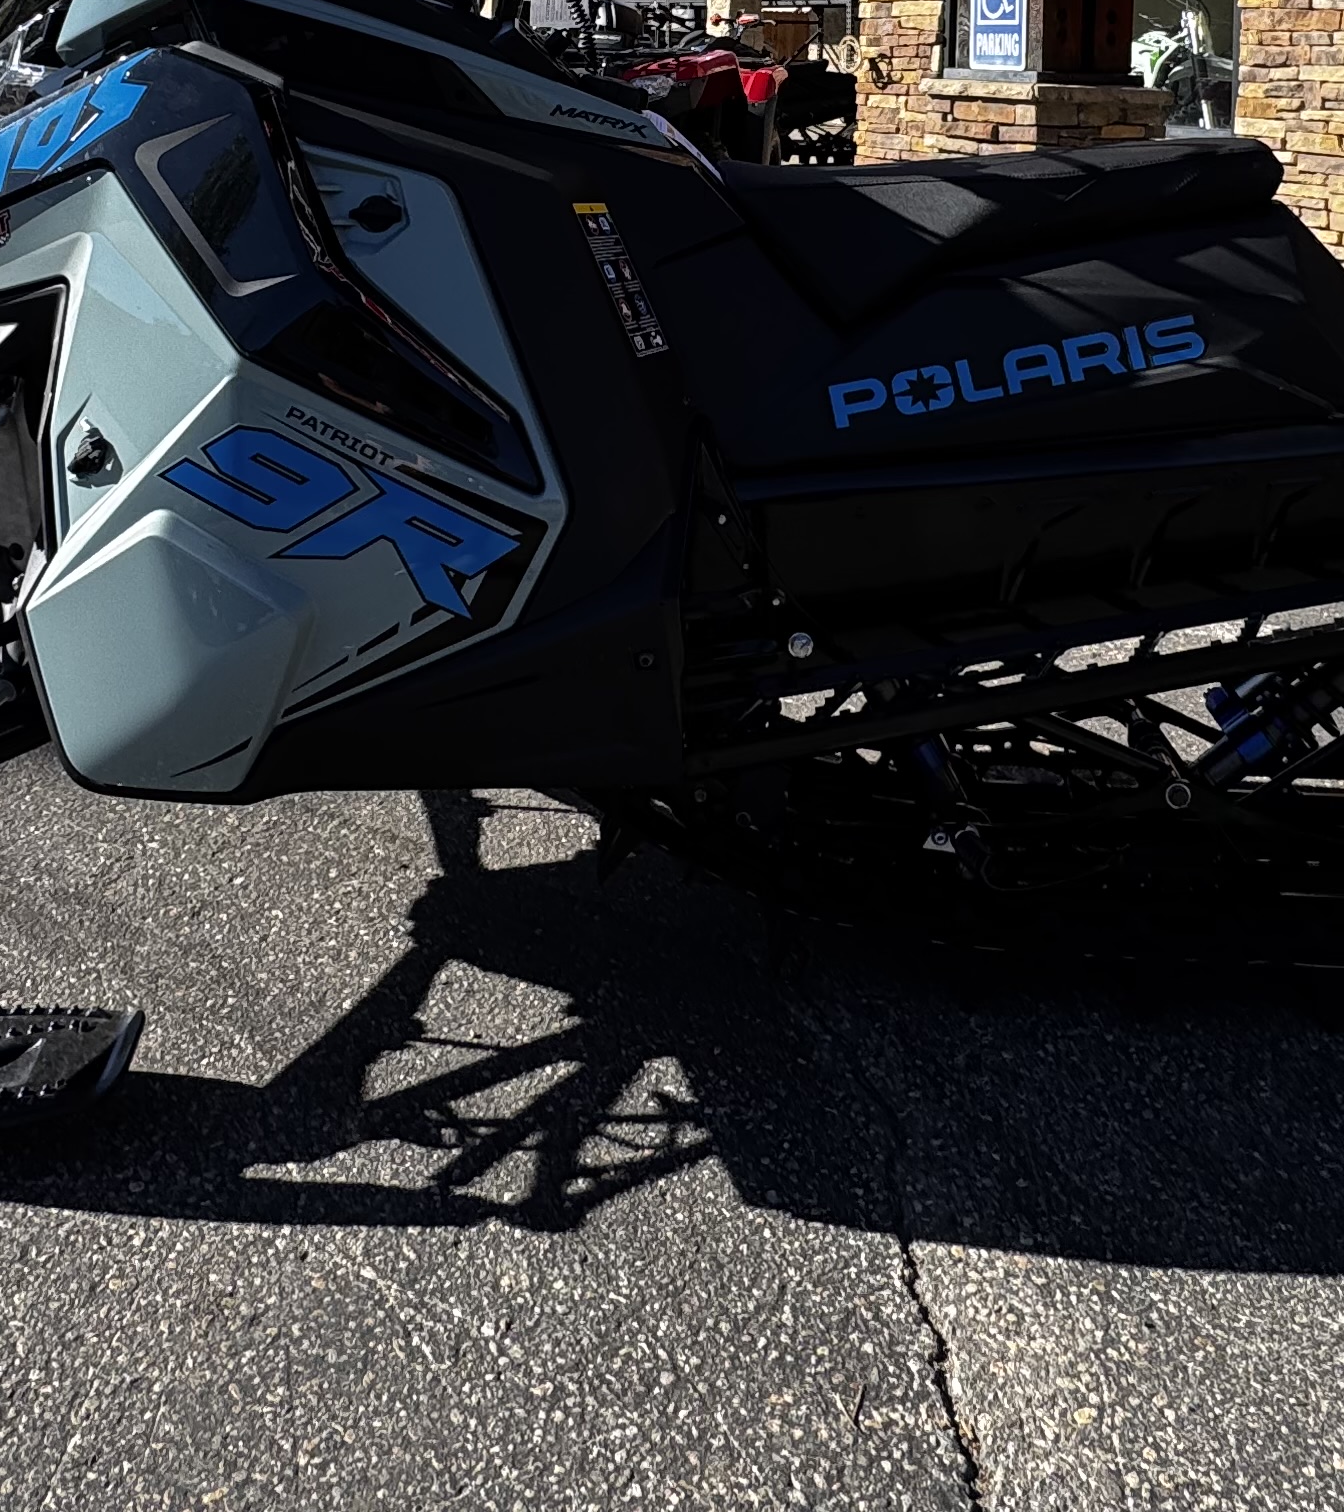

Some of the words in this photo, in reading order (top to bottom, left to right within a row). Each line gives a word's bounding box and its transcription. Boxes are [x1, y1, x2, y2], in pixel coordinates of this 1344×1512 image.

[976, 33, 1019, 57] PARKING
[550, 104, 648, 139] MATRYX
[828, 313, 1206, 430] POLARIS
[285, 406, 395, 466] PATRIOT
[157, 425, 522, 621] 9R
